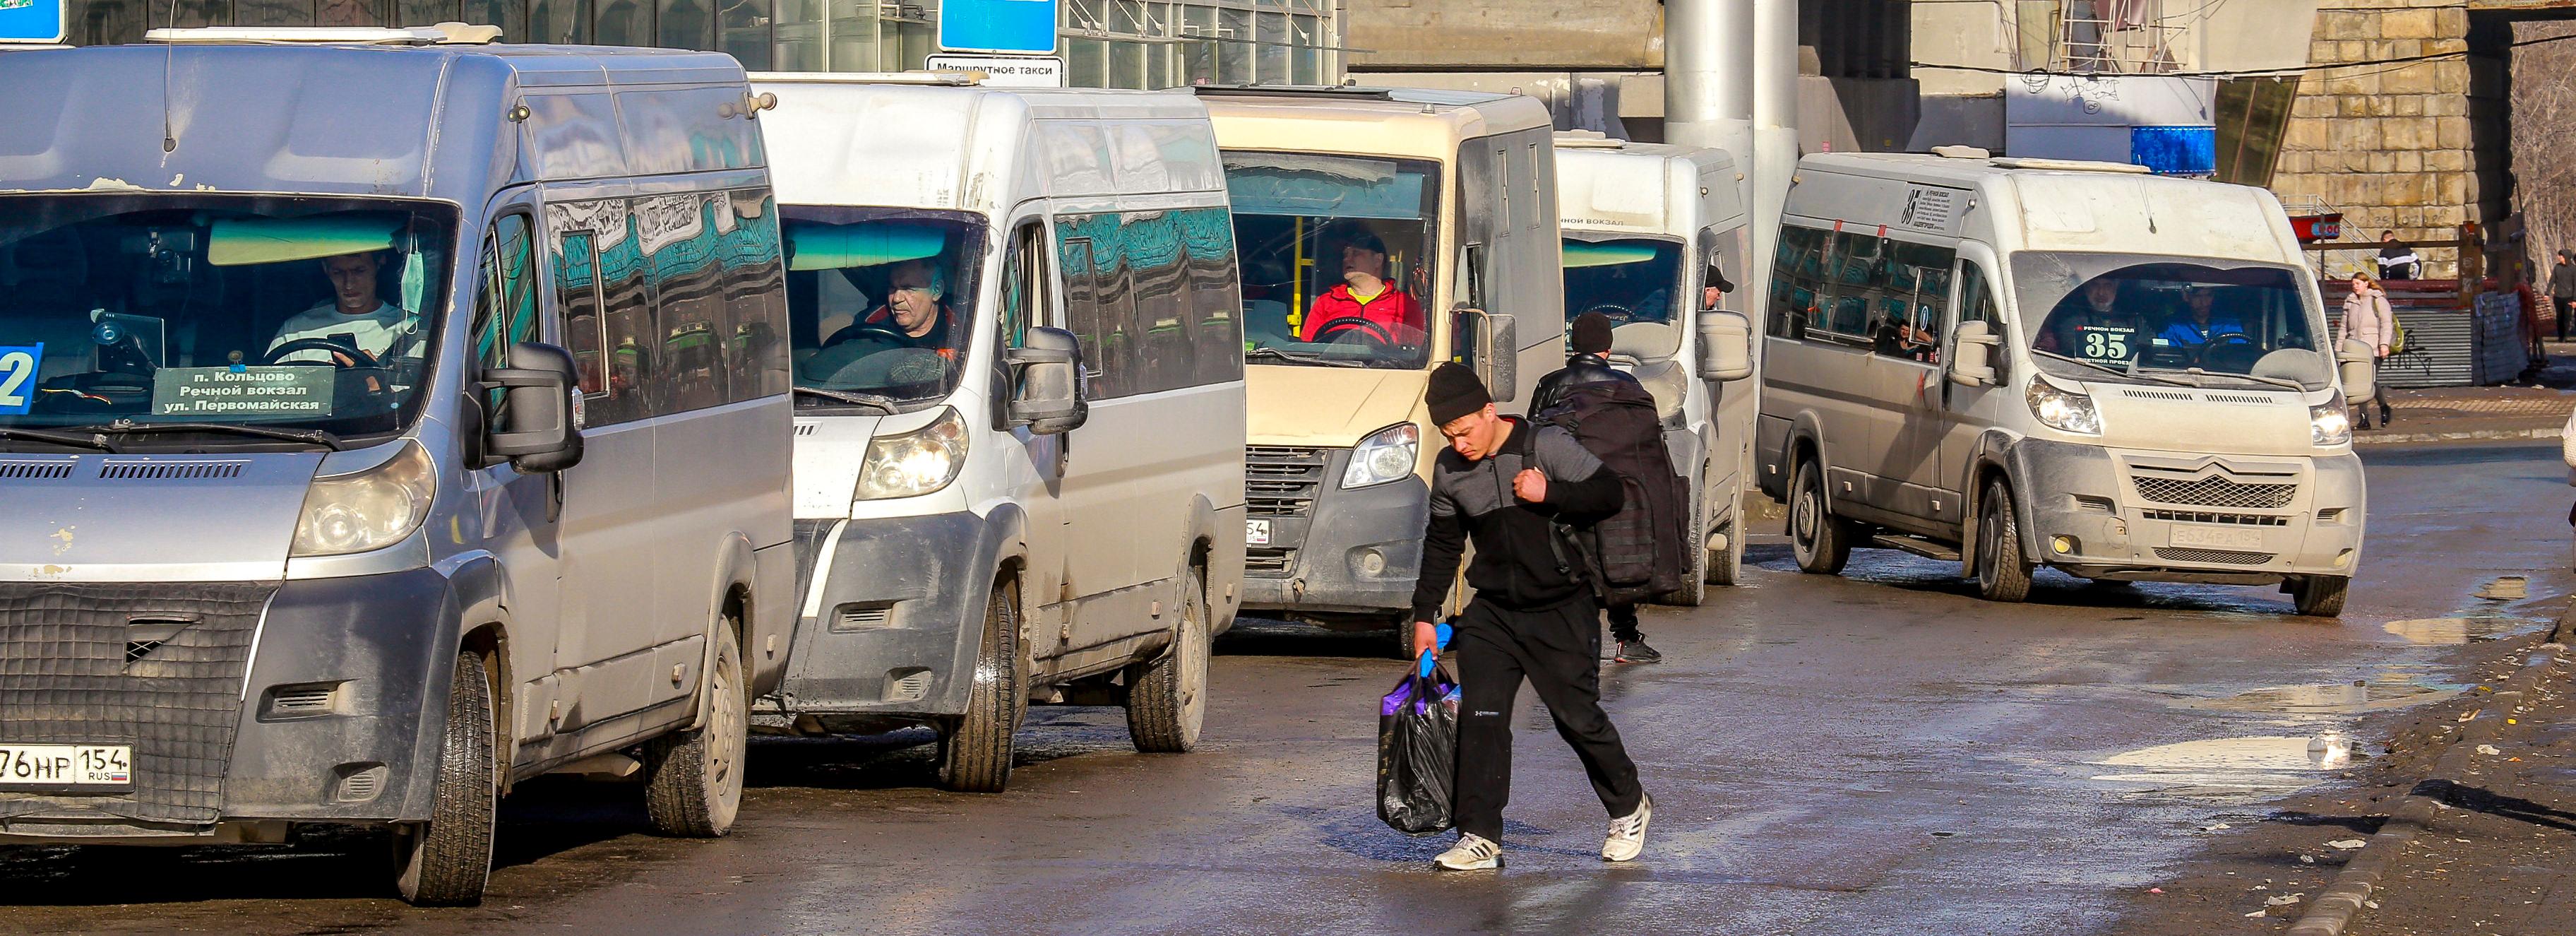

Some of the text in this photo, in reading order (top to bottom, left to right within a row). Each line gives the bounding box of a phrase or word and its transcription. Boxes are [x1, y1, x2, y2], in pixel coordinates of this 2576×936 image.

[1018, 66, 1052, 75] такси
[1901, 189, 1921, 225] 35
[2085, 333, 2127, 359] 35
[0, 352, 33, 406] 2
[194, 372, 295, 383] п. Кольцово
[179, 385, 306, 396] Речной вокзал
[164, 399, 319, 414] ул. Первомайская
[80, 749, 122, 770] 154
[89, 772, 110, 781] RUS
